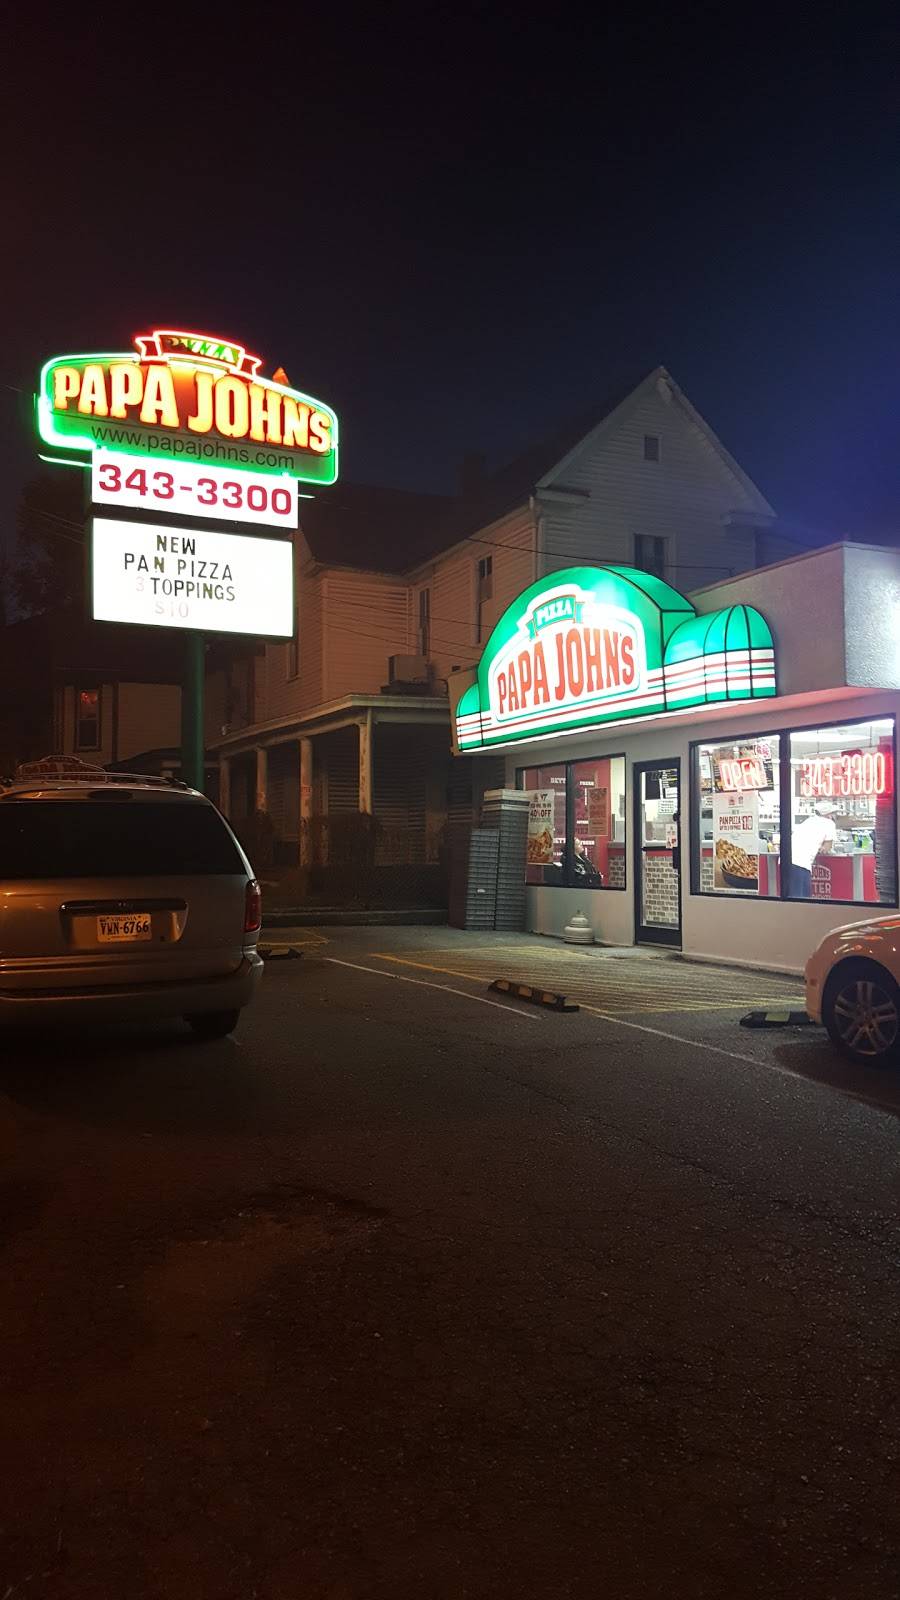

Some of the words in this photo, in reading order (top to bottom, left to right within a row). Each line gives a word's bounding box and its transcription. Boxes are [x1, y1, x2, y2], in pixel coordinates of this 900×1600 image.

[54, 364, 179, 428] PAPA
[92, 426, 295, 470] www.papajohns.com
[99, 464, 292, 515] 343-3300
[156, 535, 196, 556] NEW
[124, 553, 164, 573] PAN
[177, 559, 233, 581] PIZZA
[136, 576, 144, 591] 3
[150, 577, 235, 601] TOPPINGS
[536, 600, 572, 626] PIZZA
[497, 641, 550, 714] PAPA
[721, 760, 762, 788] OPEN
[802, 753, 885, 796] 343-3300
